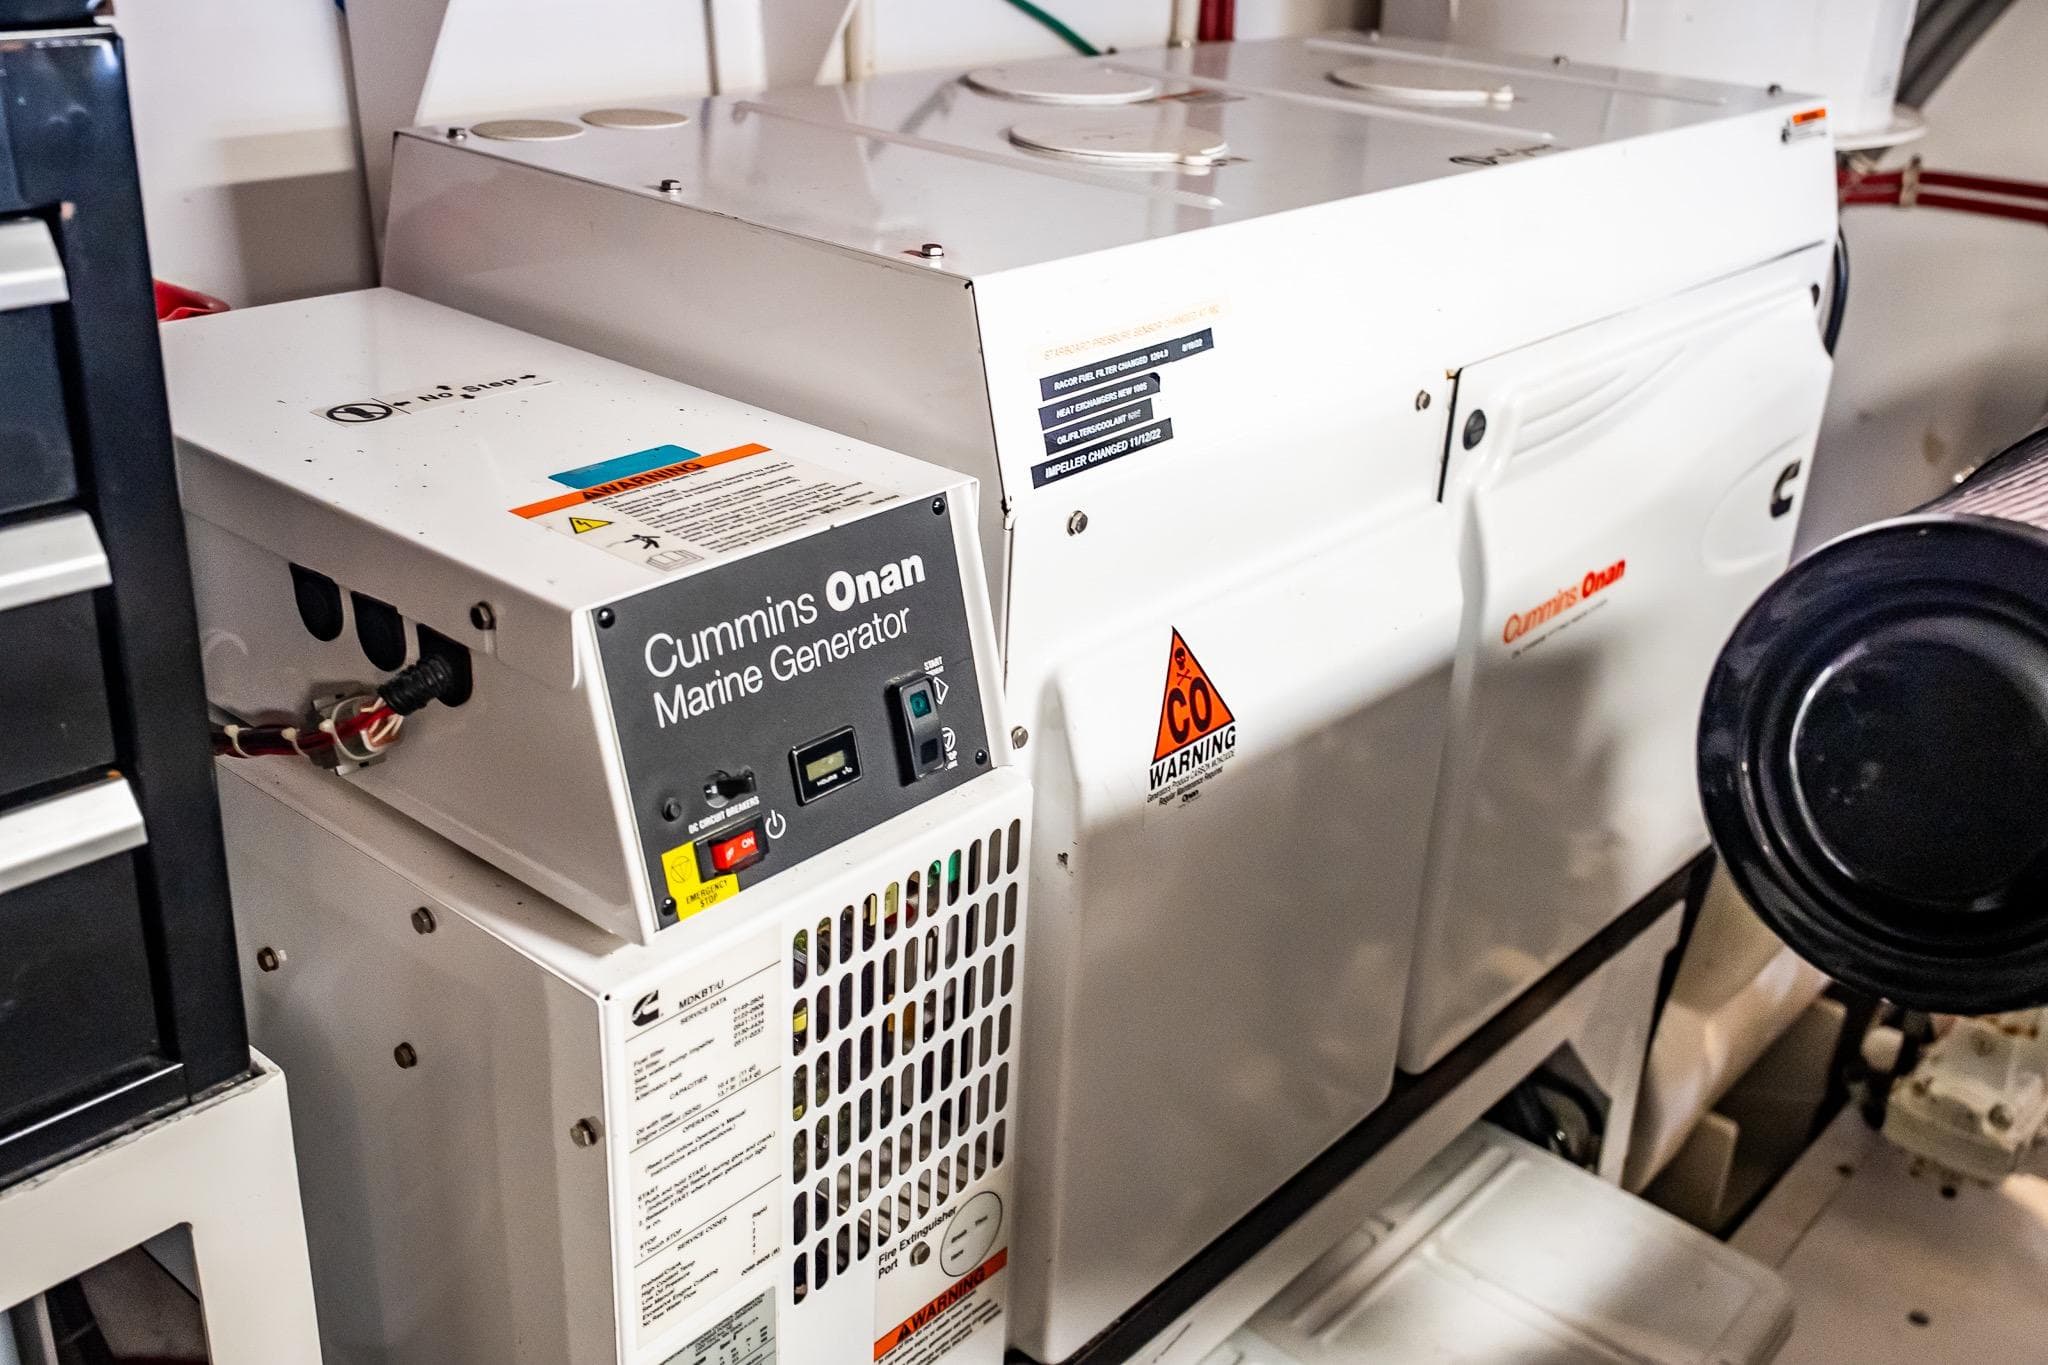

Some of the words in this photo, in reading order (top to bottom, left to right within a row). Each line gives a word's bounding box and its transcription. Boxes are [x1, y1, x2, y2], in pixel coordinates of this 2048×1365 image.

[417, 392, 453, 402] No
[462, 379, 518, 392] Step
[1054, 376, 1078, 391] RACOR
[1078, 371, 1096, 384] FUEL
[1095, 365, 1118, 379] FILTER
[1117, 355, 1148, 372] CHANGED
[1056, 405, 1075, 419] HEAT
[1074, 392, 1118, 413] EXCHANGERS
[1117, 387, 1133, 399] NEW
[1045, 455, 1087, 478] IMPELLER
[1088, 440, 1129, 463] CHANGED
[594, 462, 705, 497] WARNING
[644, 593, 818, 678] Cummins
[825, 554, 926, 611] Onan
[1503, 586, 1578, 644] Cummins
[1581, 559, 1625, 599] Onan
[653, 665, 763, 728] Marine
[770, 607, 910, 681] Generator
[1167, 677, 1212, 744] CO
[1149, 725, 1236, 791] WARNING
[688, 822, 699, 834] DC
[699, 810, 725, 829] CIRCUIT
[725, 795, 760, 817] BREAKERS
[741, 837, 755, 849] ON
[686, 879, 728, 904] EMERGENCY
[700, 892, 718, 907] STOP
[710, 996, 727, 1009] DATA
[878, 1248, 897, 1266] Fire
[899, 1206, 957, 1251] Extinguisher
[878, 1258, 898, 1279] Port
[911, 1266, 985, 1330] WARNING
